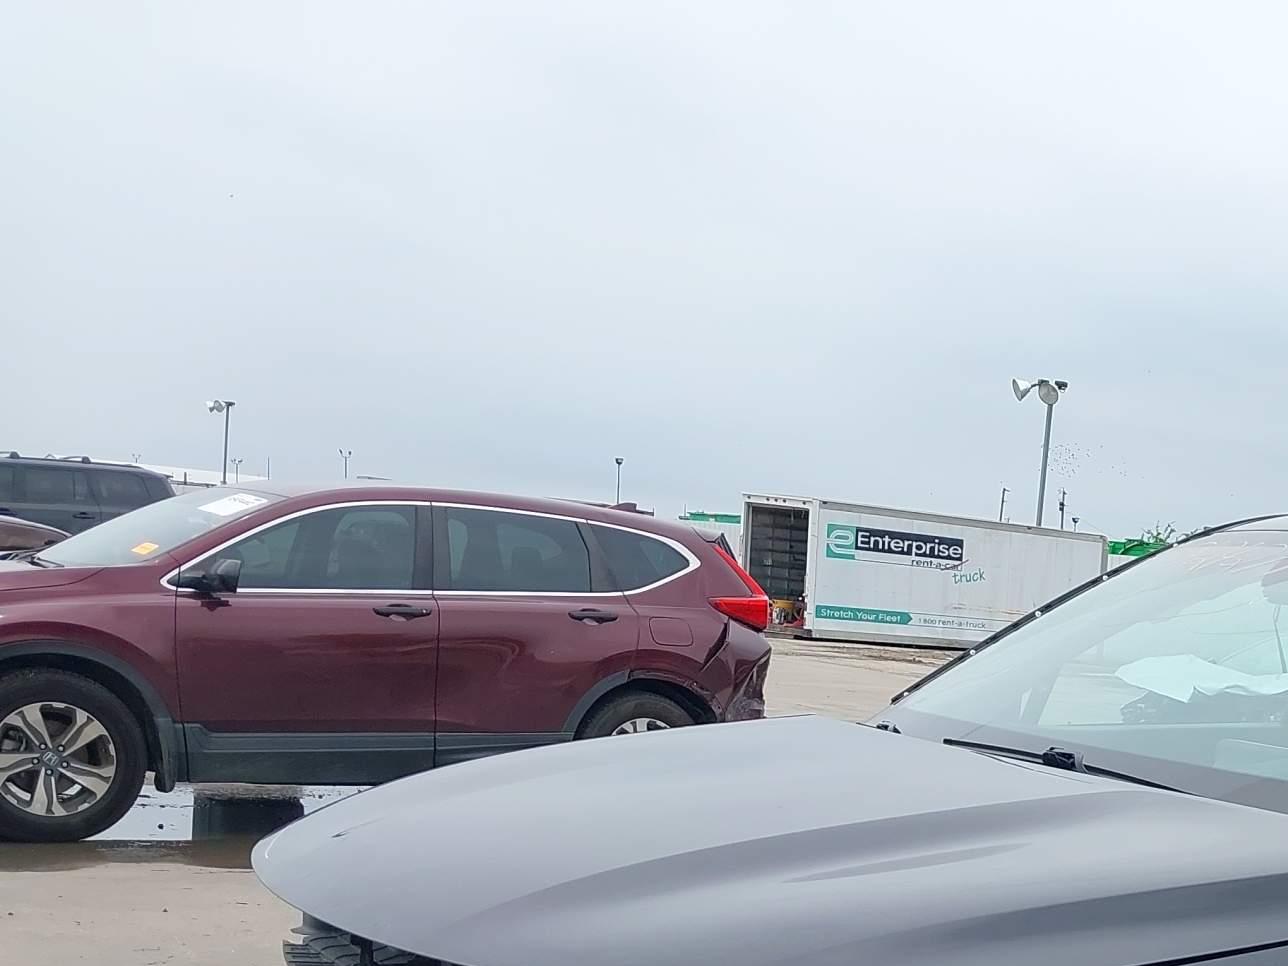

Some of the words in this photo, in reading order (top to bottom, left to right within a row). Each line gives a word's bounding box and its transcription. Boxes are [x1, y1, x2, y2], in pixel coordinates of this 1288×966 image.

[857, 531, 963, 559] Enterprise
[952, 568, 986, 585] truck
[820, 608, 854, 619] Stretch
[857, 611, 877, 621] Your
[878, 613, 901, 624] Fleet
[937, 618, 986, 629] rent-a-truck
